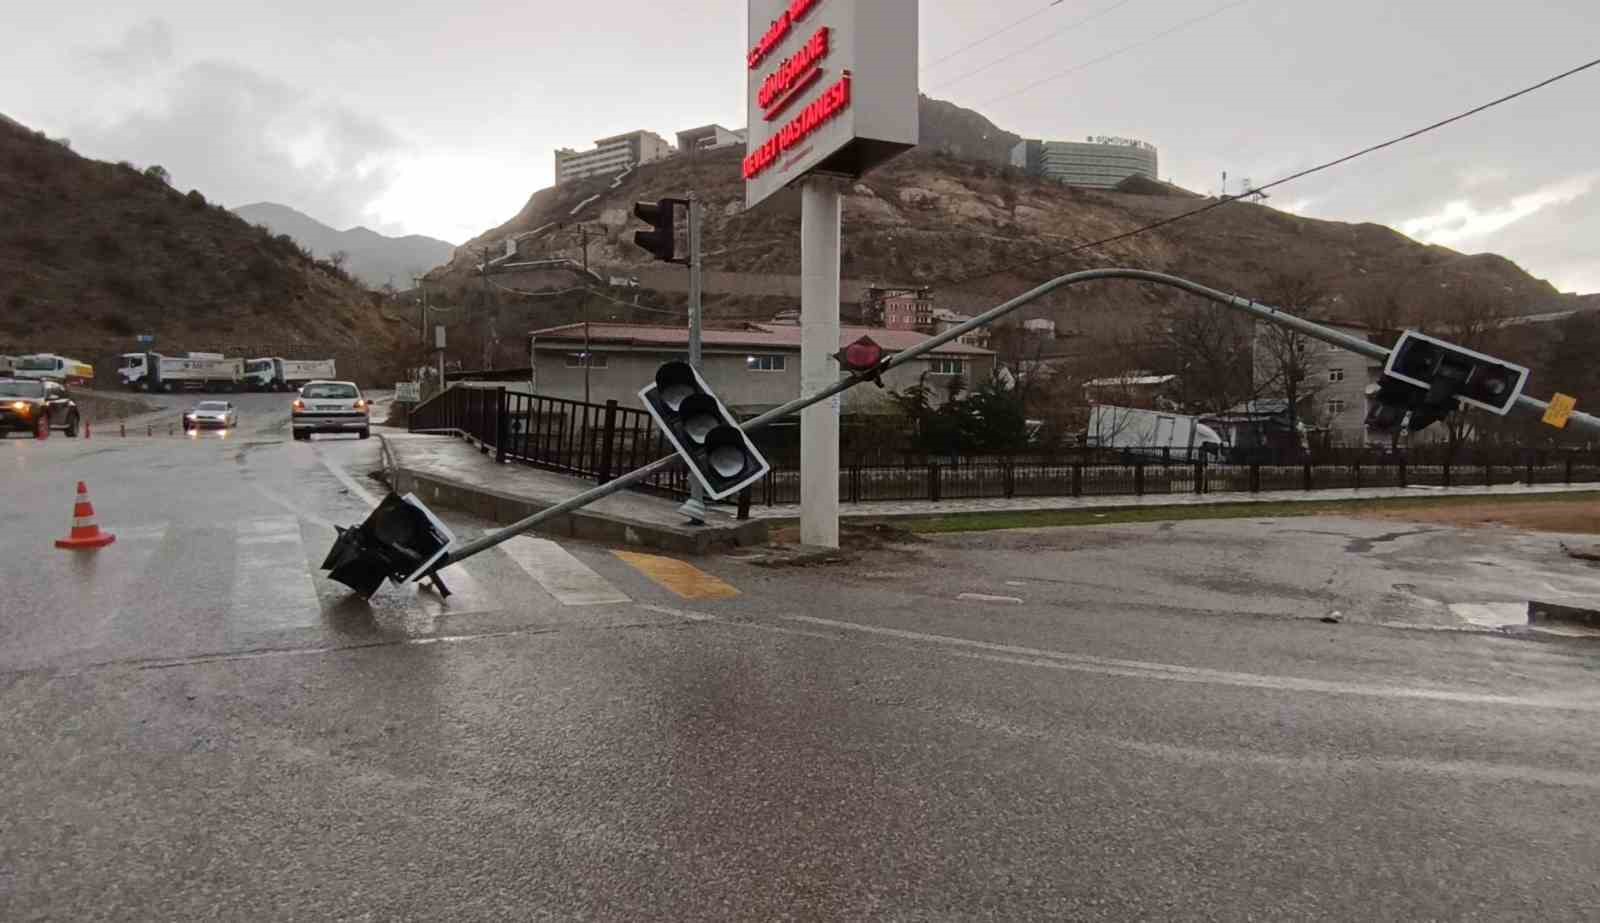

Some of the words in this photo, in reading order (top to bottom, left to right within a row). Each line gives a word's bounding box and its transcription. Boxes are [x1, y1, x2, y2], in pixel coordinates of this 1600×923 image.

[758, 27, 829, 109] GÜMÜŞHANE
[743, 132, 781, 180] DEVLET
[779, 70, 852, 151] HASTANESİ
